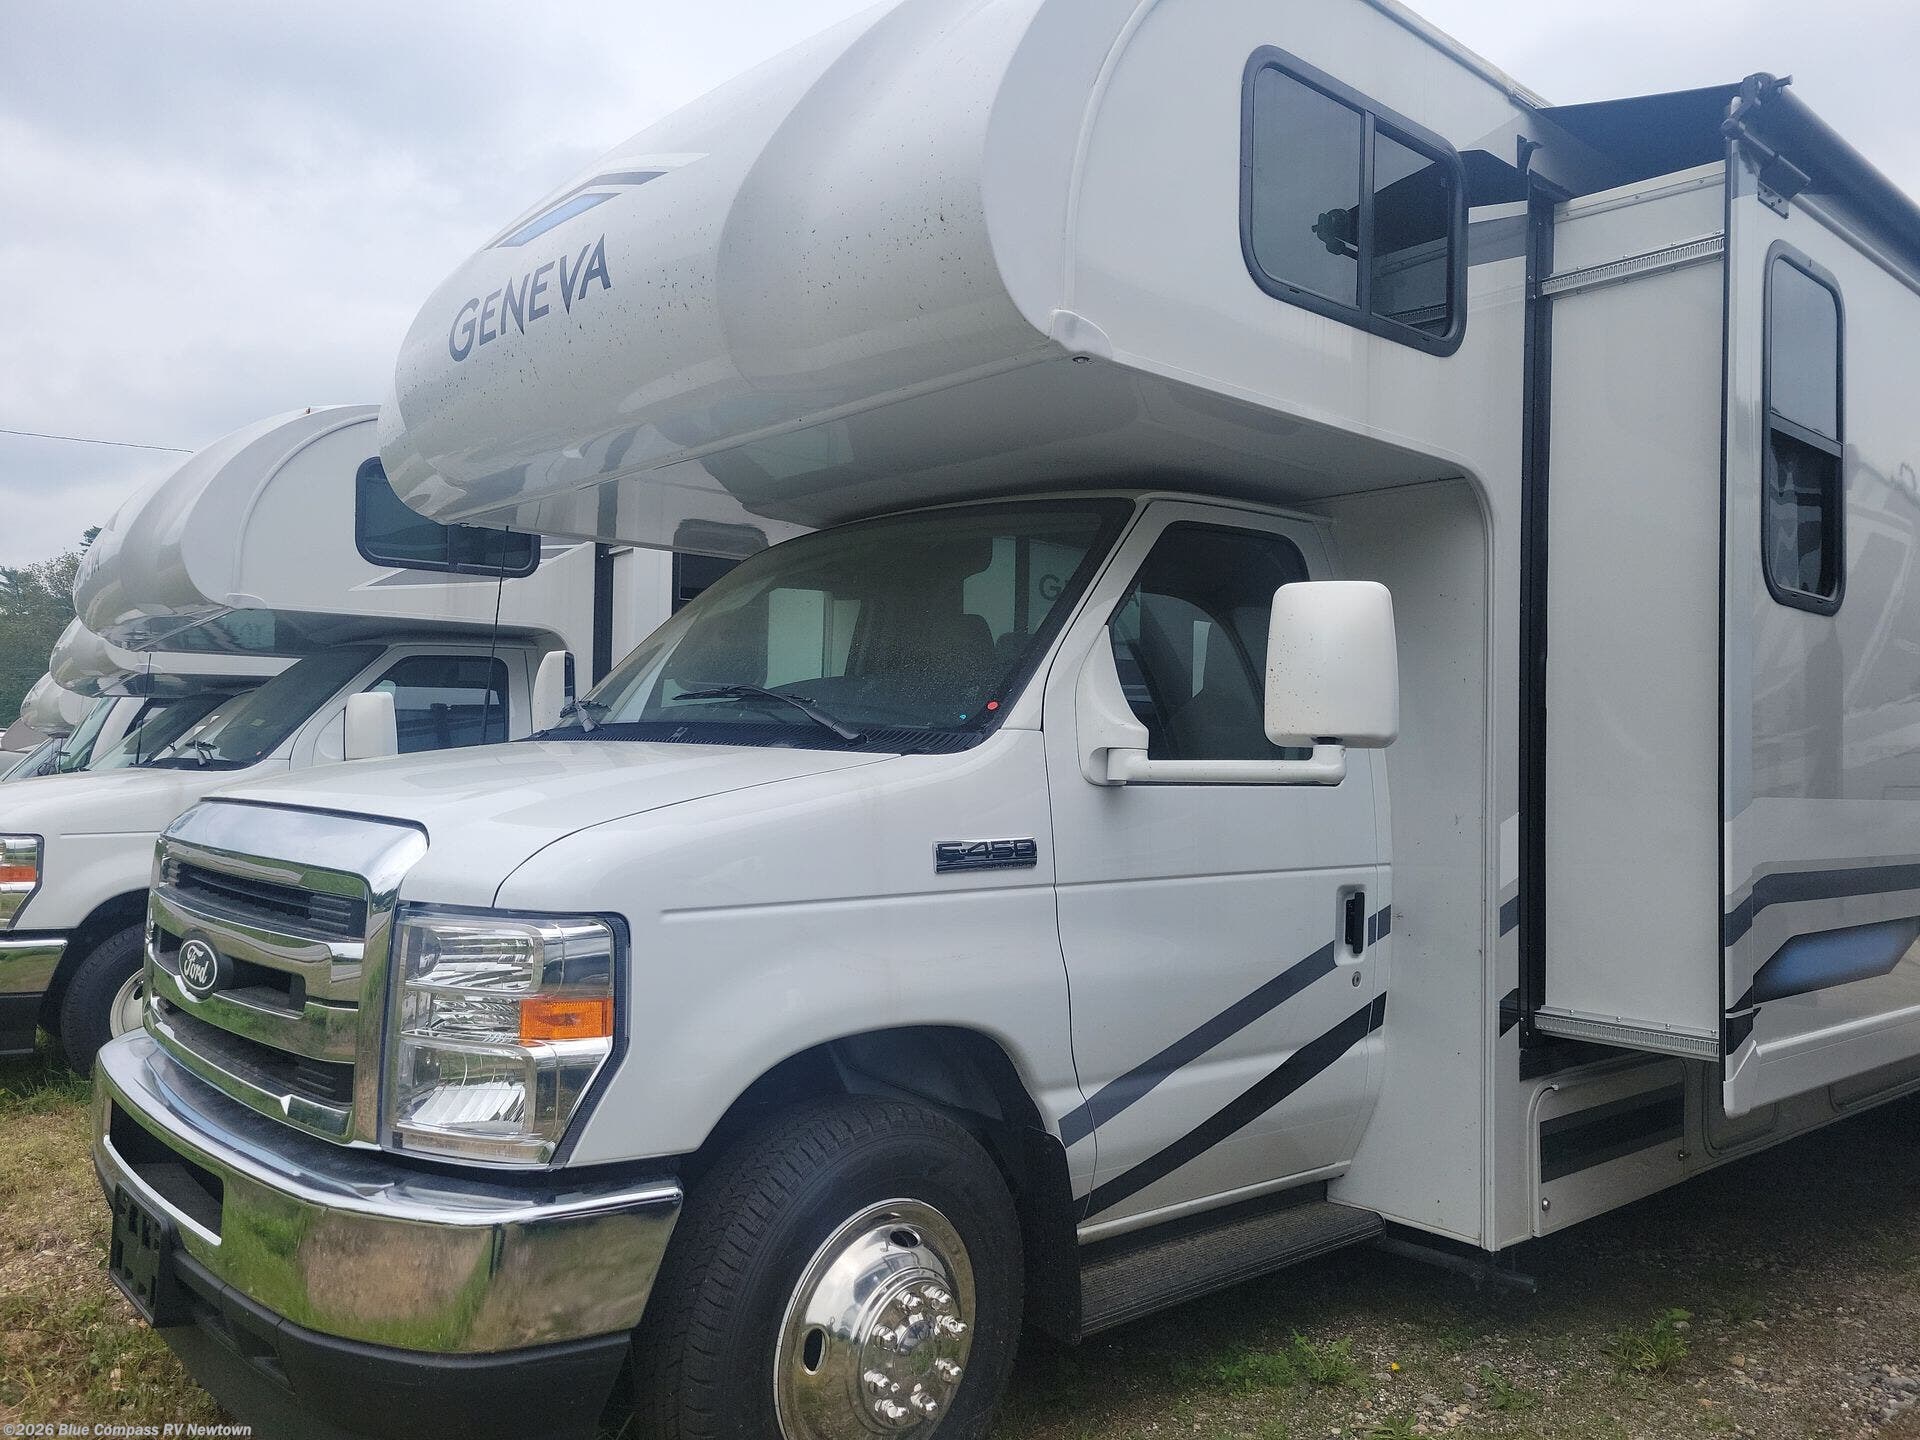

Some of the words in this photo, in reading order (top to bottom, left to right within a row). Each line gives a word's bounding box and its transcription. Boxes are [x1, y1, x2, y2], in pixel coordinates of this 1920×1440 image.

[449, 233, 612, 362] GENEVA
[937, 839, 1037, 862] E-450
[184, 945, 209, 984] Ford
